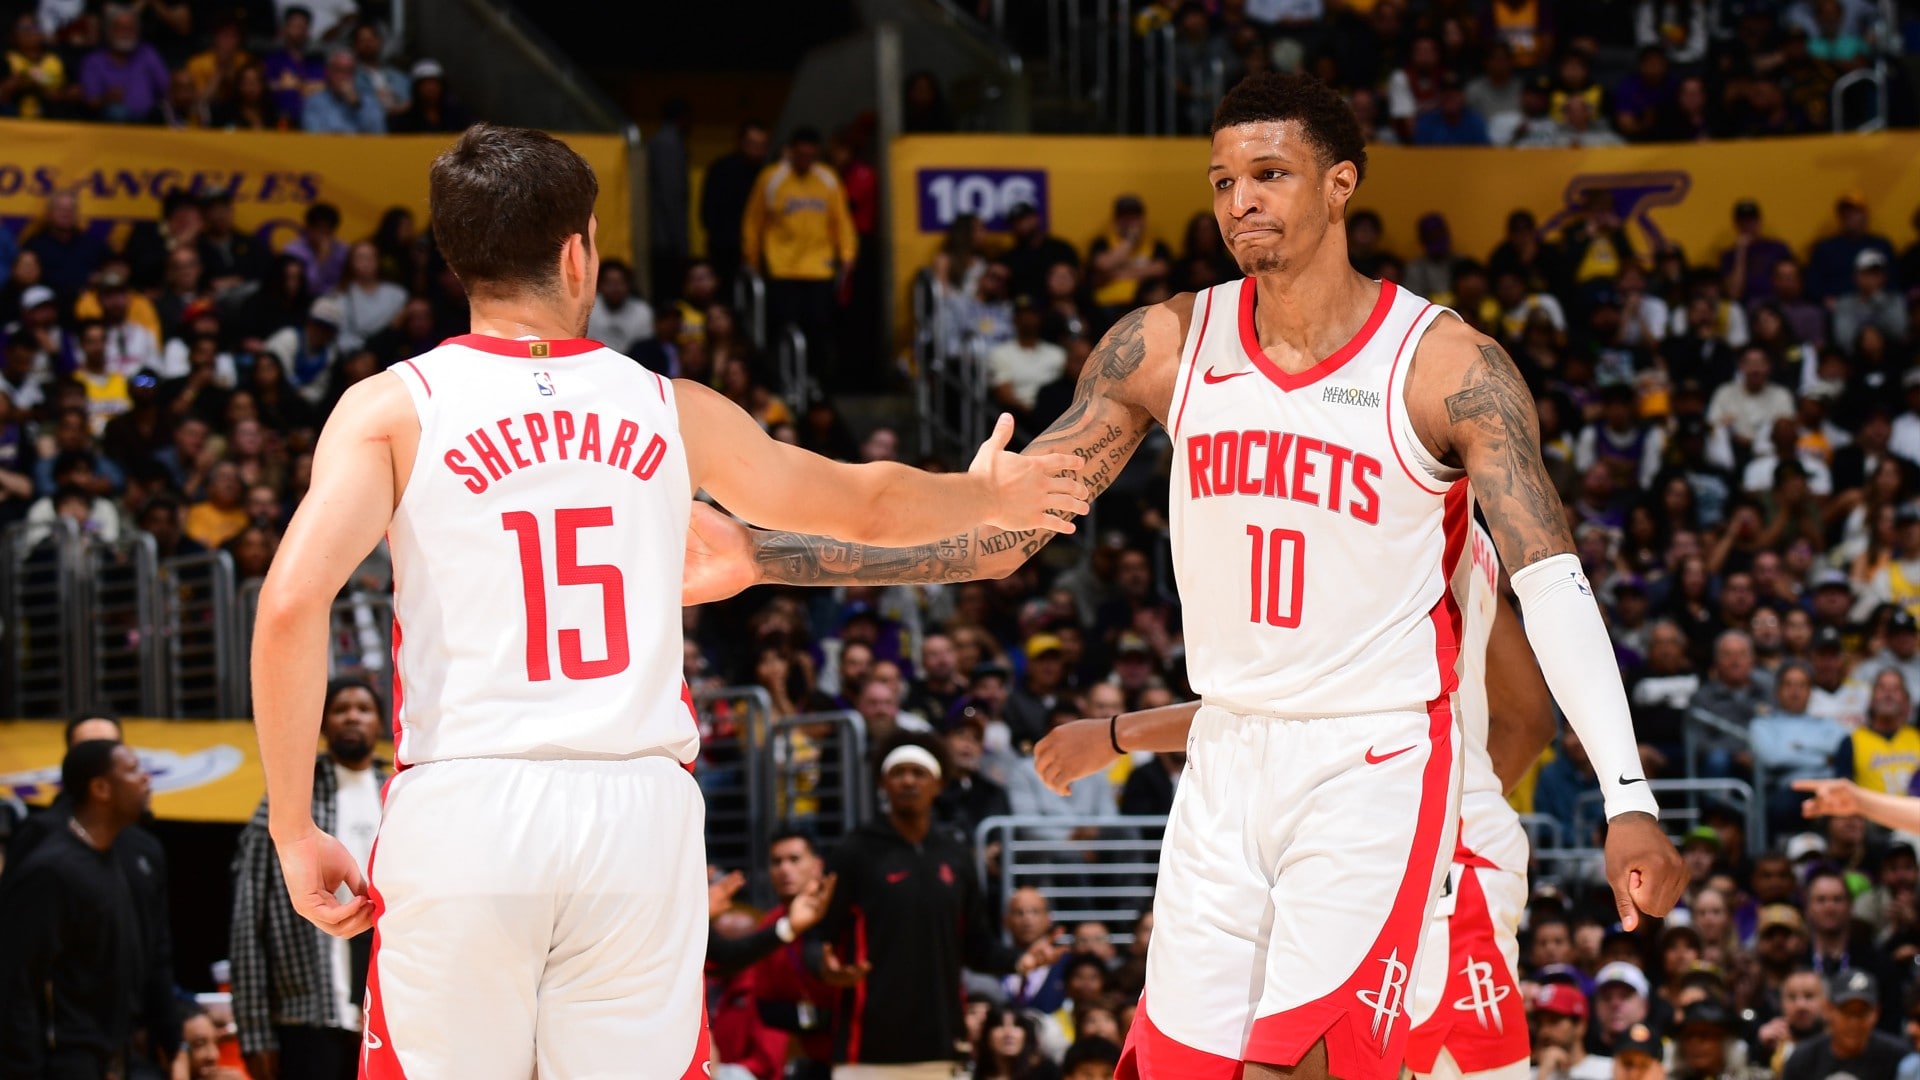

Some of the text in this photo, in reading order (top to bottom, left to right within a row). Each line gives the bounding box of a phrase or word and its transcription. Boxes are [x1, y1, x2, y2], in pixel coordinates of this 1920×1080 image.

[1322, 392, 1380, 408] HERMANN
[1323, 386, 1380, 401] MEMORIAL
[444, 410, 667, 494] SHEPPARD
[1072, 424, 1123, 464] Breeds
[1082, 459, 1111, 488] And
[1109, 427, 1146, 465] Steal
[1187, 430, 1382, 526] ROCKETS
[501, 506, 630, 681] 15
[1246, 524, 1305, 629] 10
